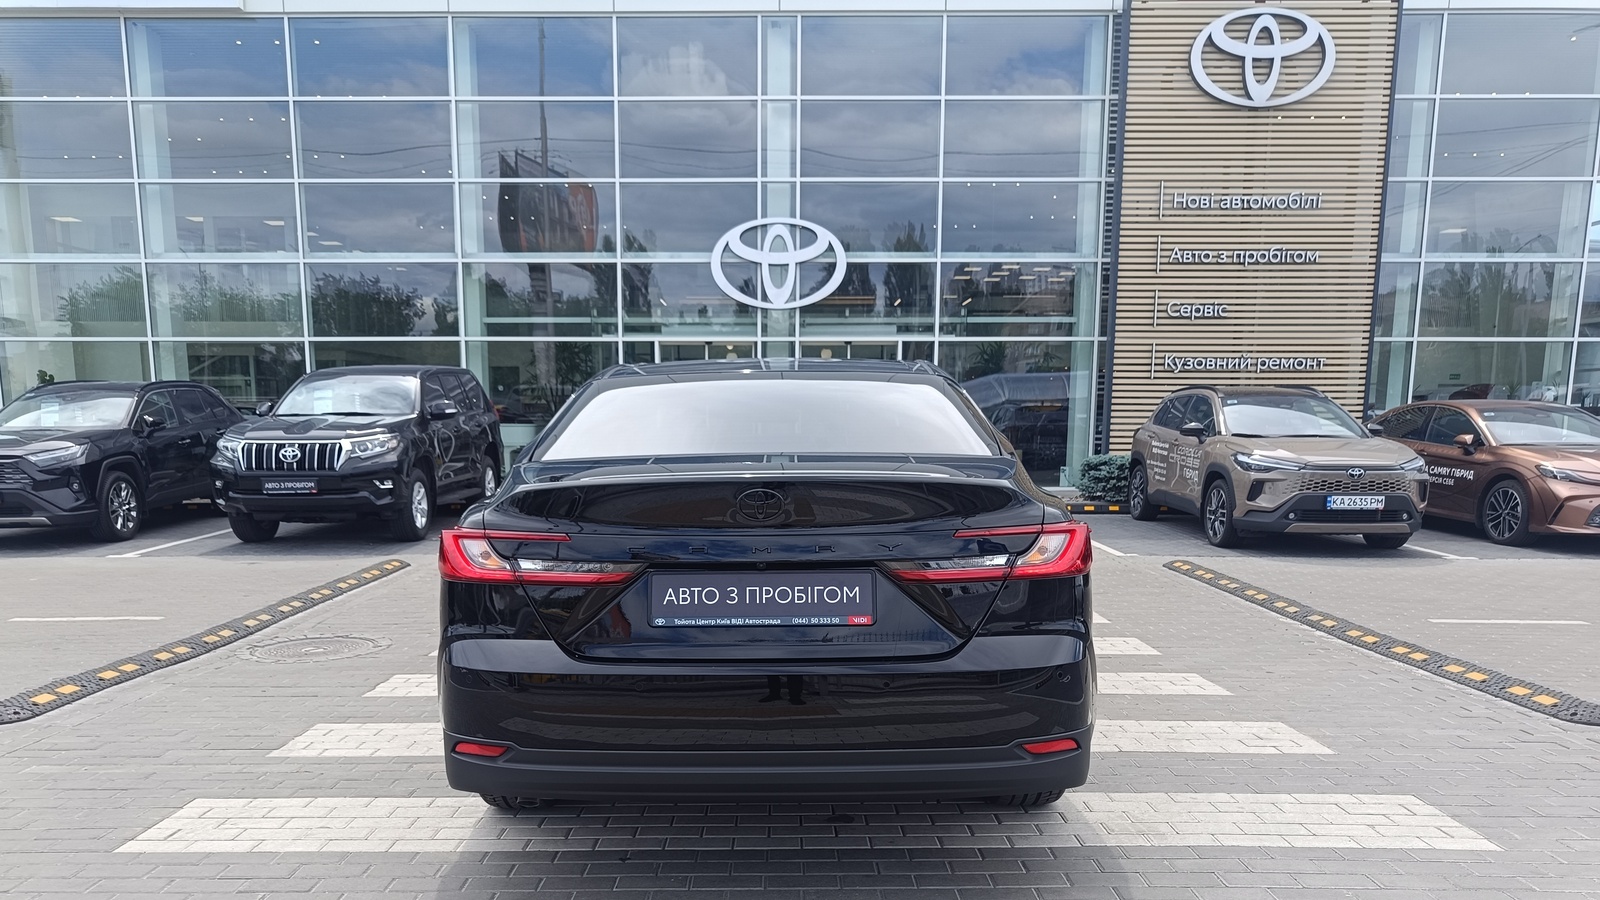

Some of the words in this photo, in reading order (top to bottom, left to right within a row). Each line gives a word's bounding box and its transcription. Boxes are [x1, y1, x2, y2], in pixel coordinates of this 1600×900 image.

[1173, 192, 1215, 209] Нові
[1220, 191, 1323, 209] автомобілі
[1169, 246, 1213, 263] Авто
[1217, 249, 1227, 263] з
[1232, 246, 1320, 267] пробігом
[1166, 301, 1230, 321] Сервіс
[1164, 353, 1251, 373] Кузовний
[1256, 356, 1327, 373] ремонт
[1346, 497, 1369, 507] 2635
[626, 543, 903, 554] CAMRY
[663, 587, 719, 605] АВТО
[726, 586, 738, 604] З
[746, 586, 860, 604] ПРОБІГОМ
